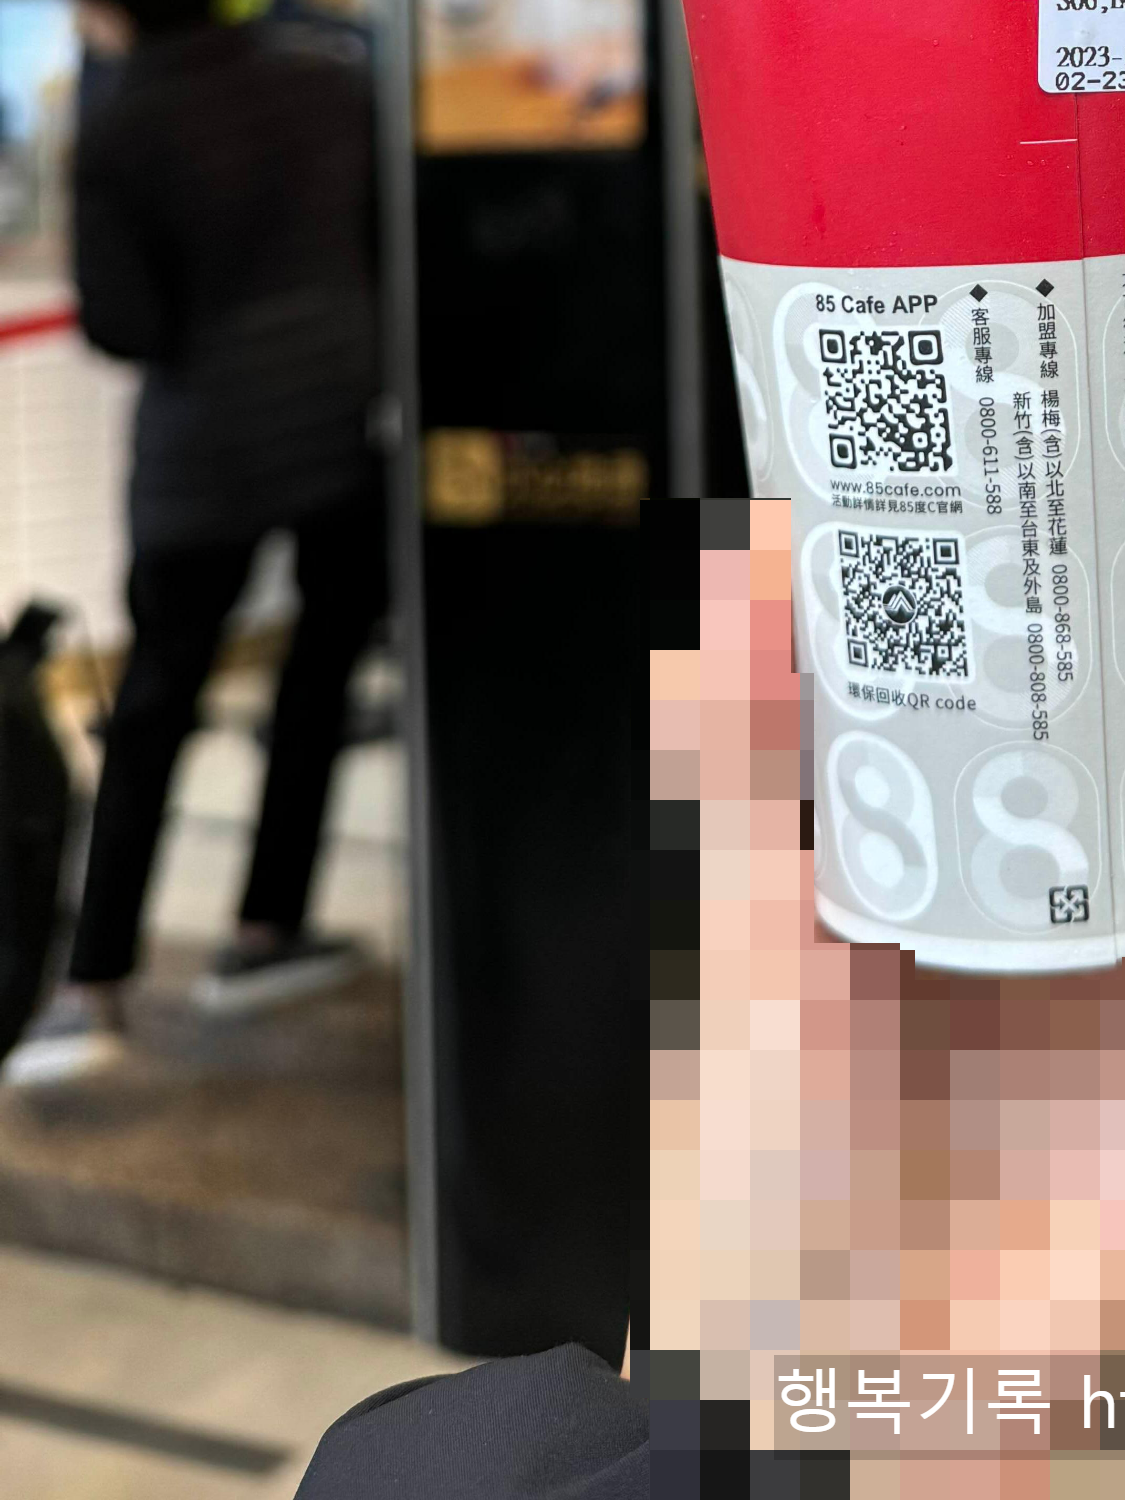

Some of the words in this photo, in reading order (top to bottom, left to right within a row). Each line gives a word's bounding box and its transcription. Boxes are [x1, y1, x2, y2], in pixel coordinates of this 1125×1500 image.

[815, 294, 836, 312] 85
[841, 295, 886, 314] Cafe
[892, 294, 938, 314] APP
[971, 307, 995, 384] 客服專線
[830, 479, 962, 497] www.85cafe.com
[978, 396, 1003, 515] 0800-611-588
[1037, 302, 1059, 379] 加盟專線
[1051, 564, 1074, 683] 0800-868-585
[935, 694, 977, 710] code
[1027, 623, 1049, 742] 0800-808-585
